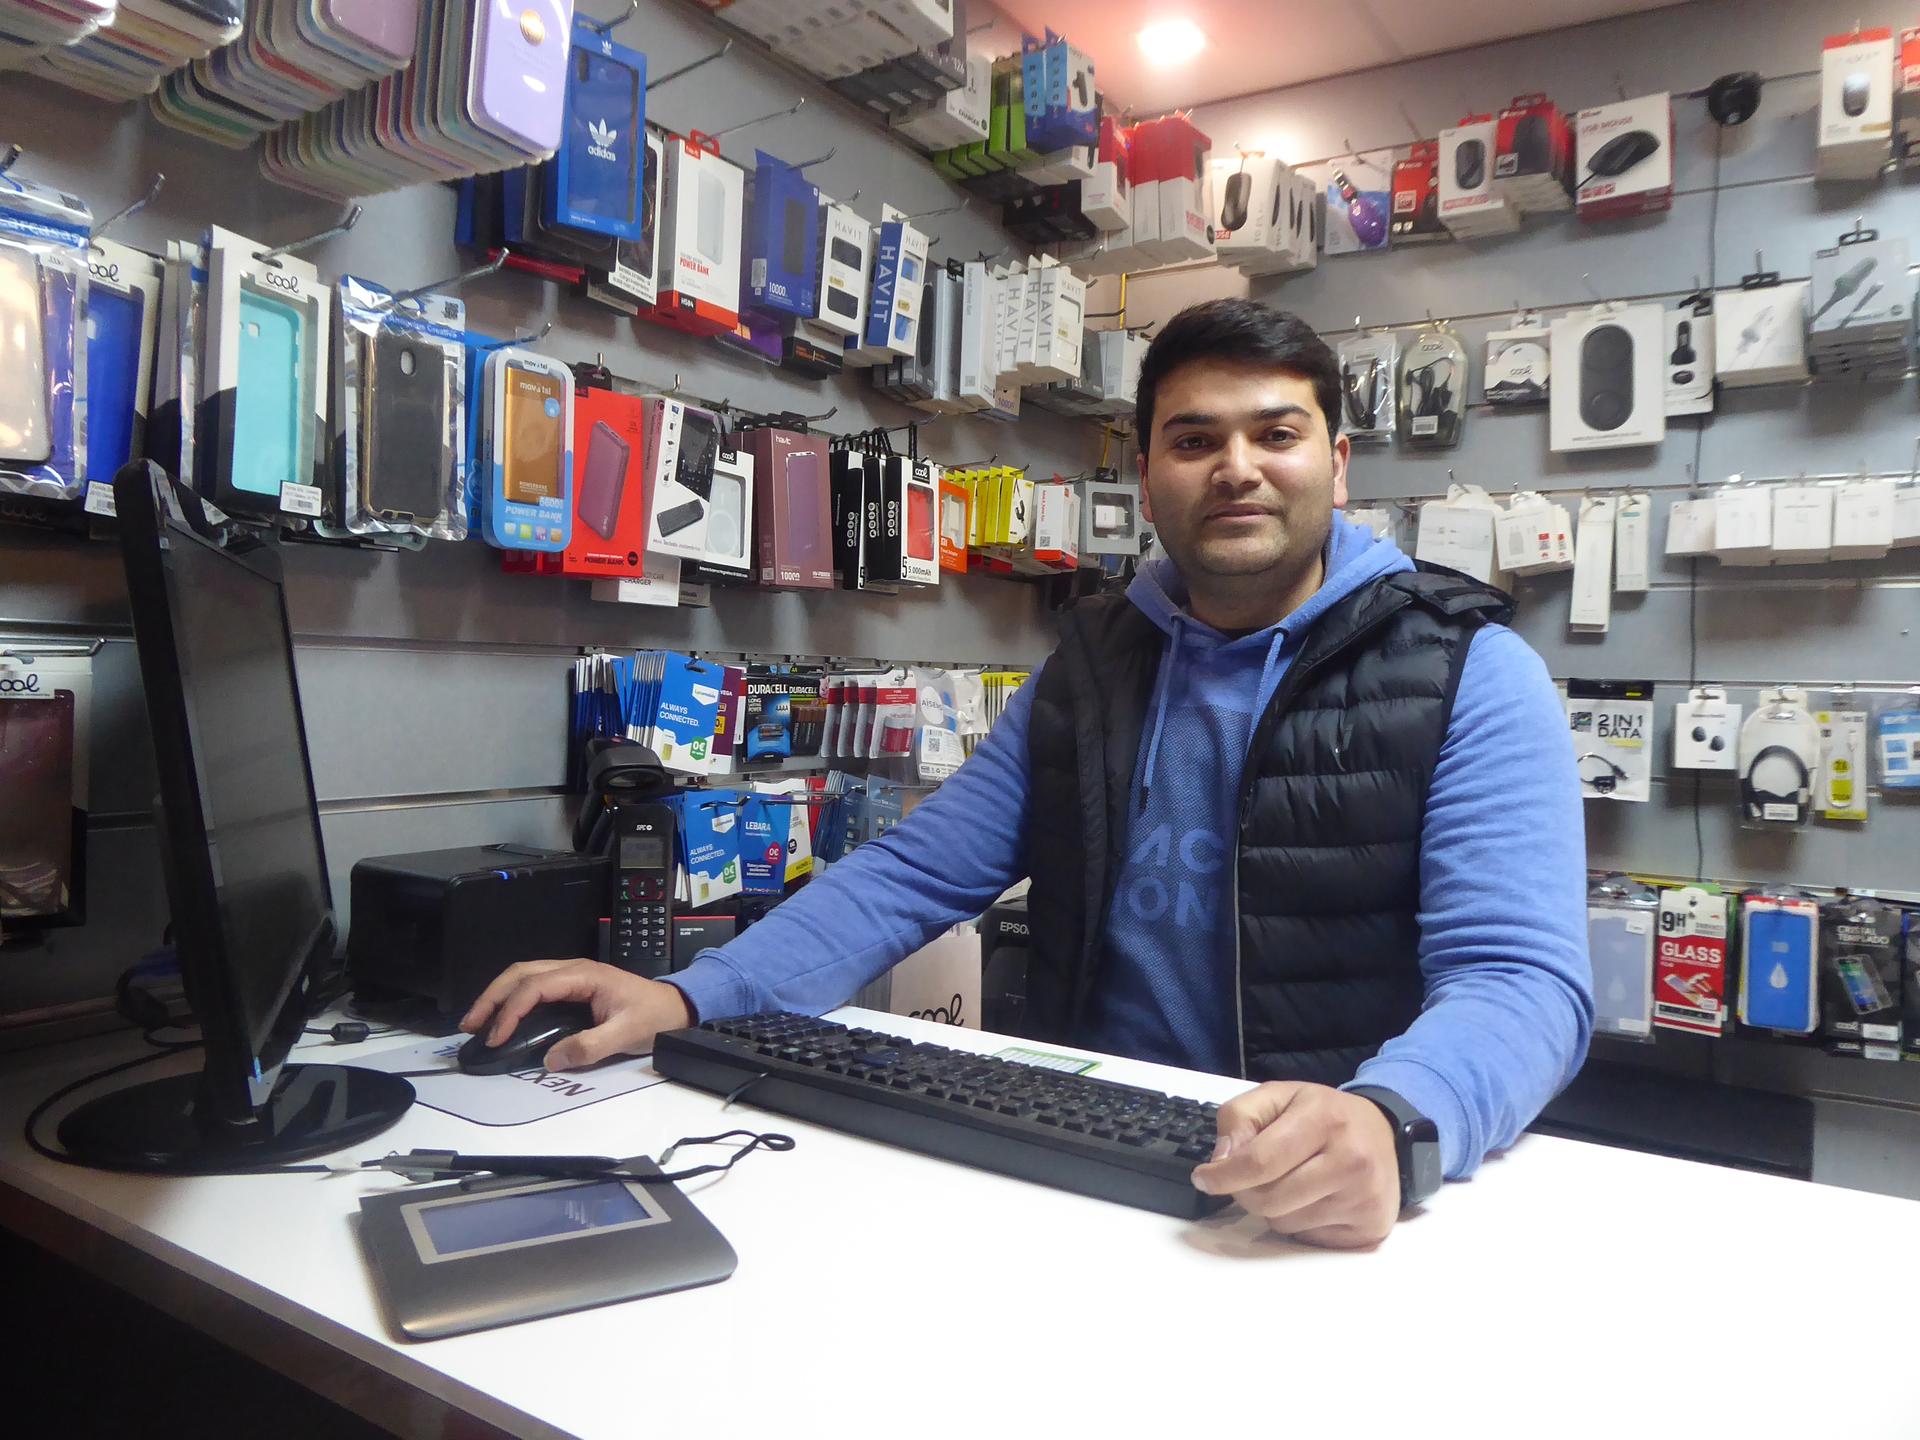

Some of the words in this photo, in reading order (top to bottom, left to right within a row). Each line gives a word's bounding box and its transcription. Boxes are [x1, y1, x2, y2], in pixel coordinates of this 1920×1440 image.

[588, 145, 617, 162] adidas
[834, 219, 863, 241] HAVIT
[905, 234, 927, 250] HAVIT
[89, 264, 120, 283] ool
[679, 257, 697, 271] POWER
[697, 263, 710, 277] BANK
[266, 271, 301, 293] cool
[768, 282, 787, 296] 10000
[873, 245, 897, 324] HAVIT
[1004, 288, 1021, 357] HAVIT
[1020, 282, 1039, 348] HAVIT
[1037, 280, 1055, 353] HAVIT
[1509, 364, 1532, 376] cool
[721, 451, 735, 462] cool
[915, 466, 929, 479] cool
[504, 505, 538, 518] POWER
[539, 508, 563, 521] BANK
[901, 556, 908, 579] 5
[0, 673, 41, 693] ool
[748, 684, 788, 695] DURACELL
[789, 686, 818, 694] DURACELL
[660, 702, 688, 715] ALWAYS
[659, 712, 700, 727] CONNECTED.
[1598, 713, 1610, 727] 2
[1613, 714, 1634, 728] IN
[1638, 715, 1644, 728] 1
[1598, 727, 1642, 739] DATA
[692, 740, 706, 752] 0€
[745, 821, 772, 831] LEBARA
[690, 844, 714, 856] ALWAYS
[768, 847, 780, 857] 0€
[723, 865, 736, 877] 0€
[1661, 911, 1687, 932] 9H
[1836, 925, 1876, 936] CRISTAL
[1837, 934, 1890, 945] TEMPLADO
[1661, 941, 1722, 964] GLASS
